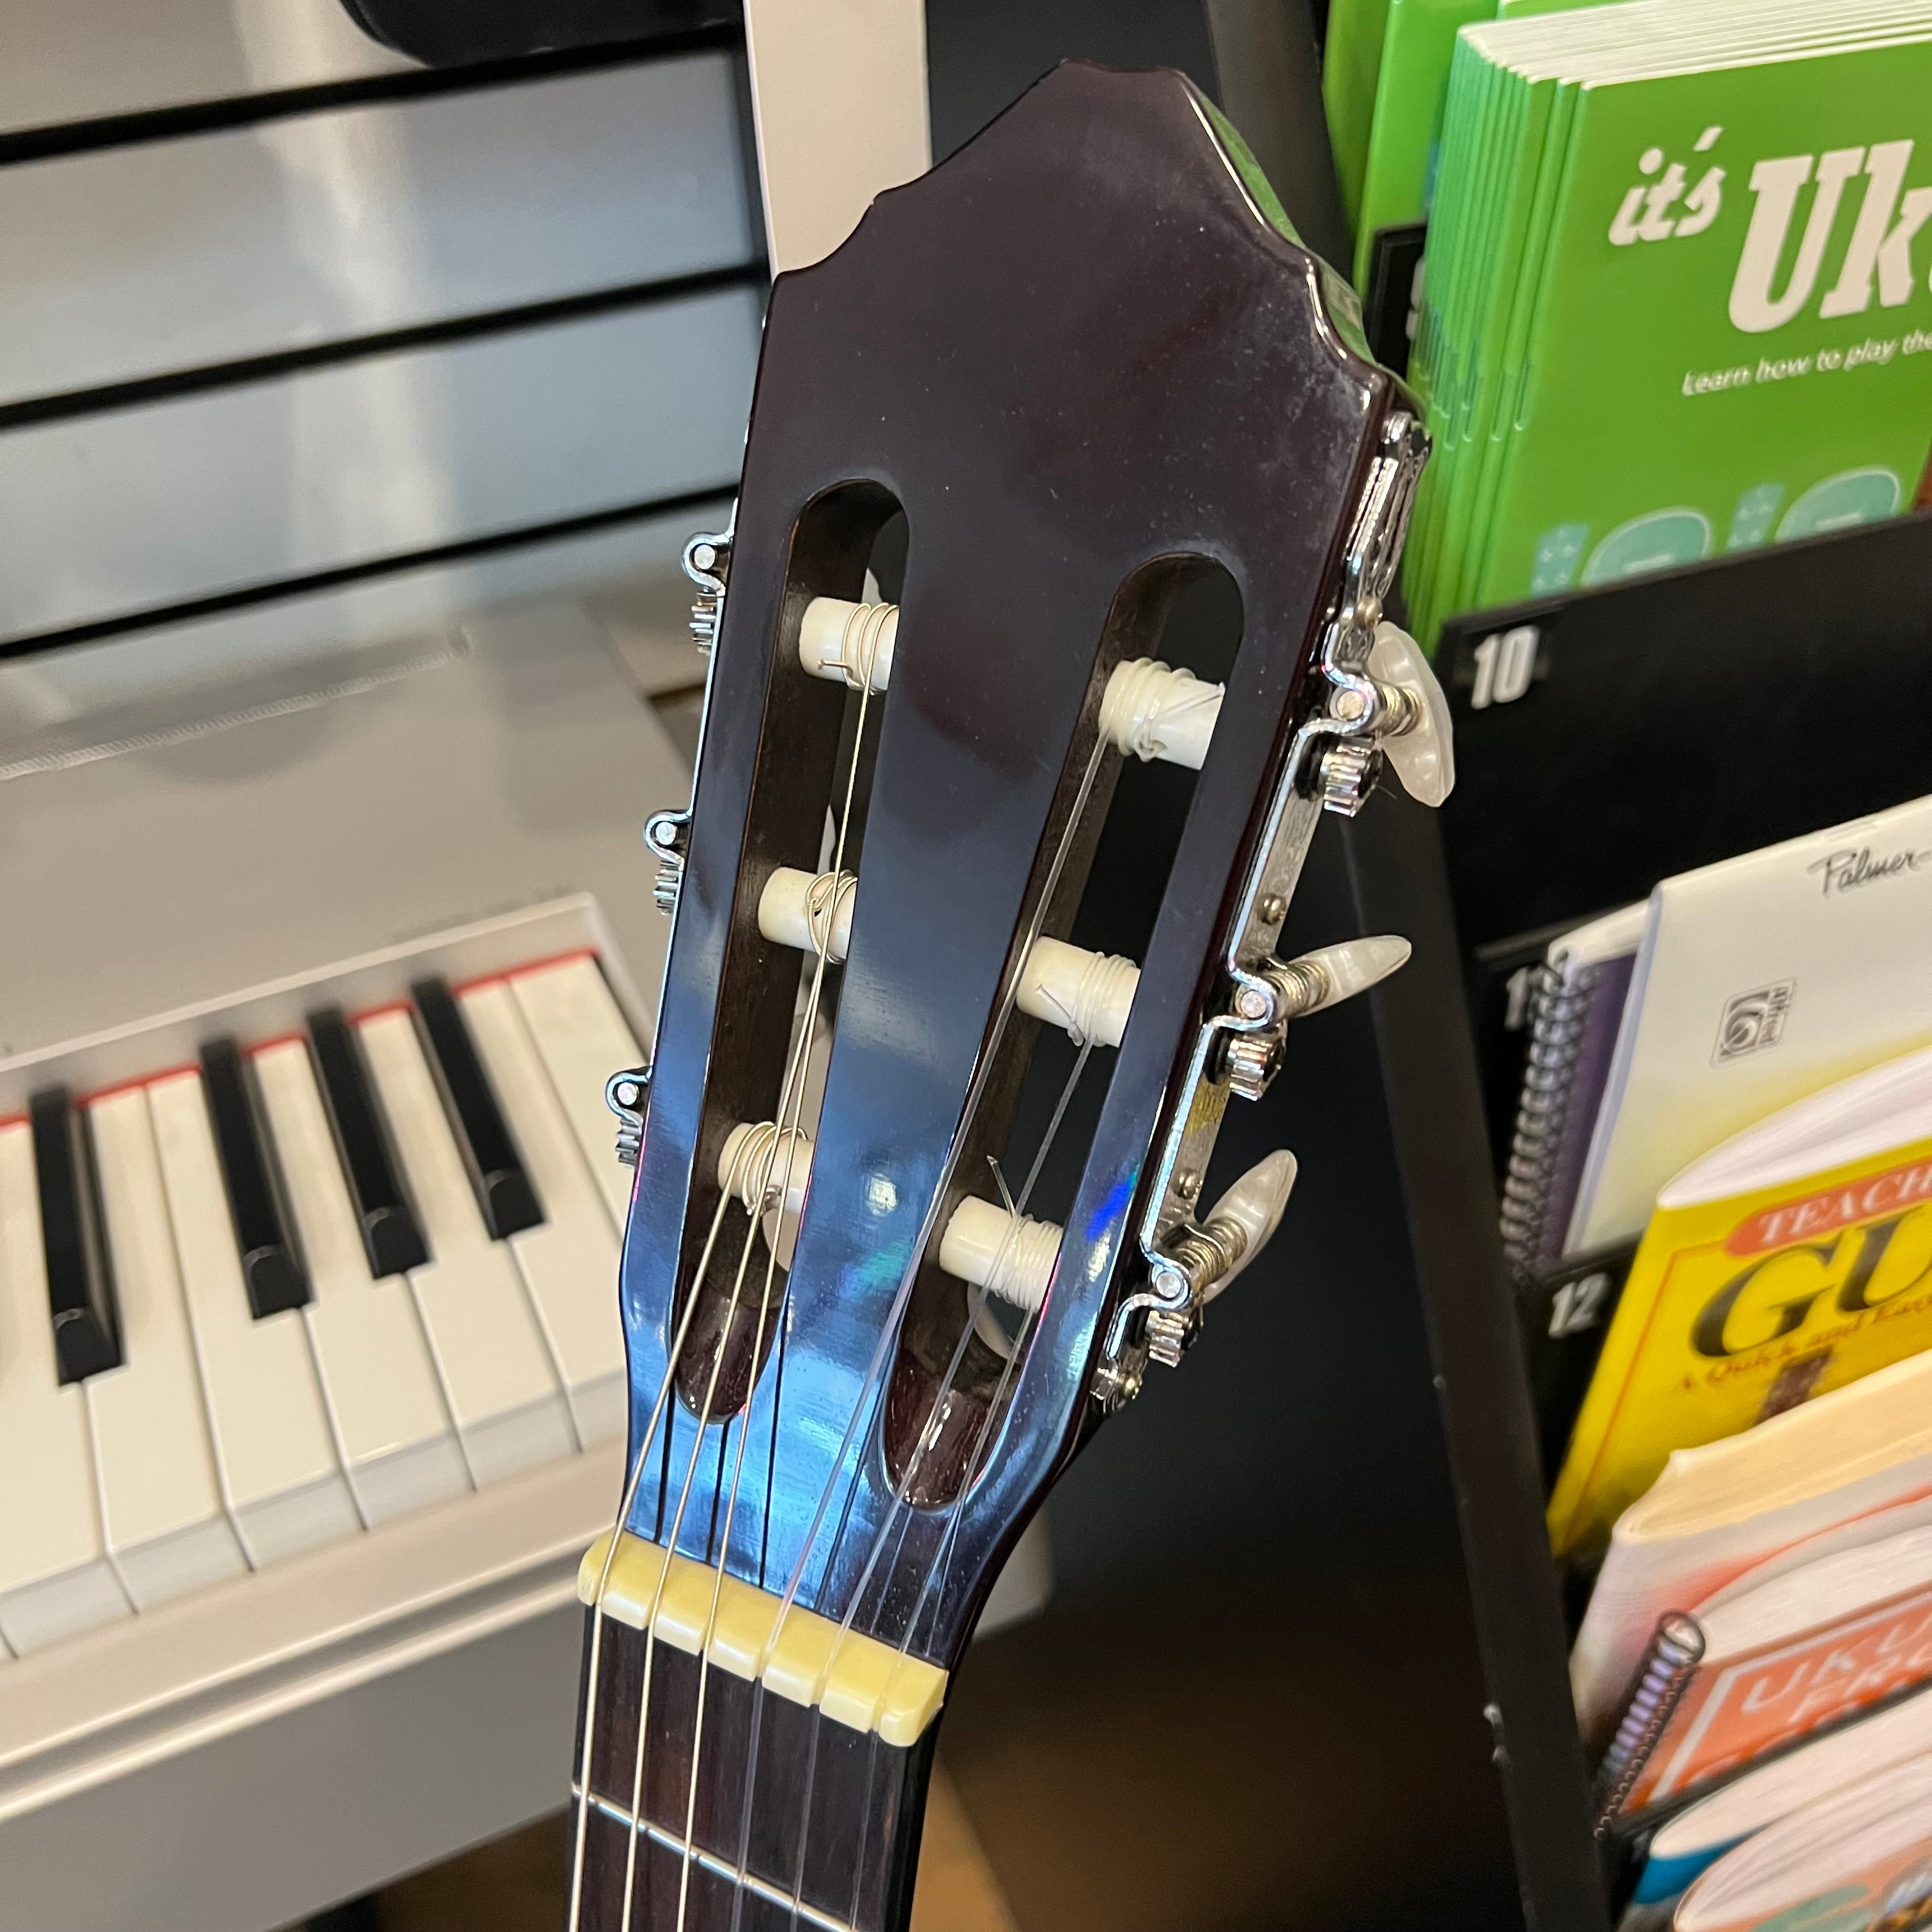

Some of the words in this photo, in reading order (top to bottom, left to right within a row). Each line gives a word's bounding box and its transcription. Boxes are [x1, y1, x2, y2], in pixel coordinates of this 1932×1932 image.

[1608, 126, 1726, 247] it's
[1728, 138, 1932, 334] Uk
[1682, 369, 1752, 397] Learn
[1754, 356, 1813, 383] how
[1816, 348, 1844, 372] to
[1843, 337, 1897, 372] play
[1471, 624, 1540, 710] 10
[1547, 1273, 1610, 1340] 12
